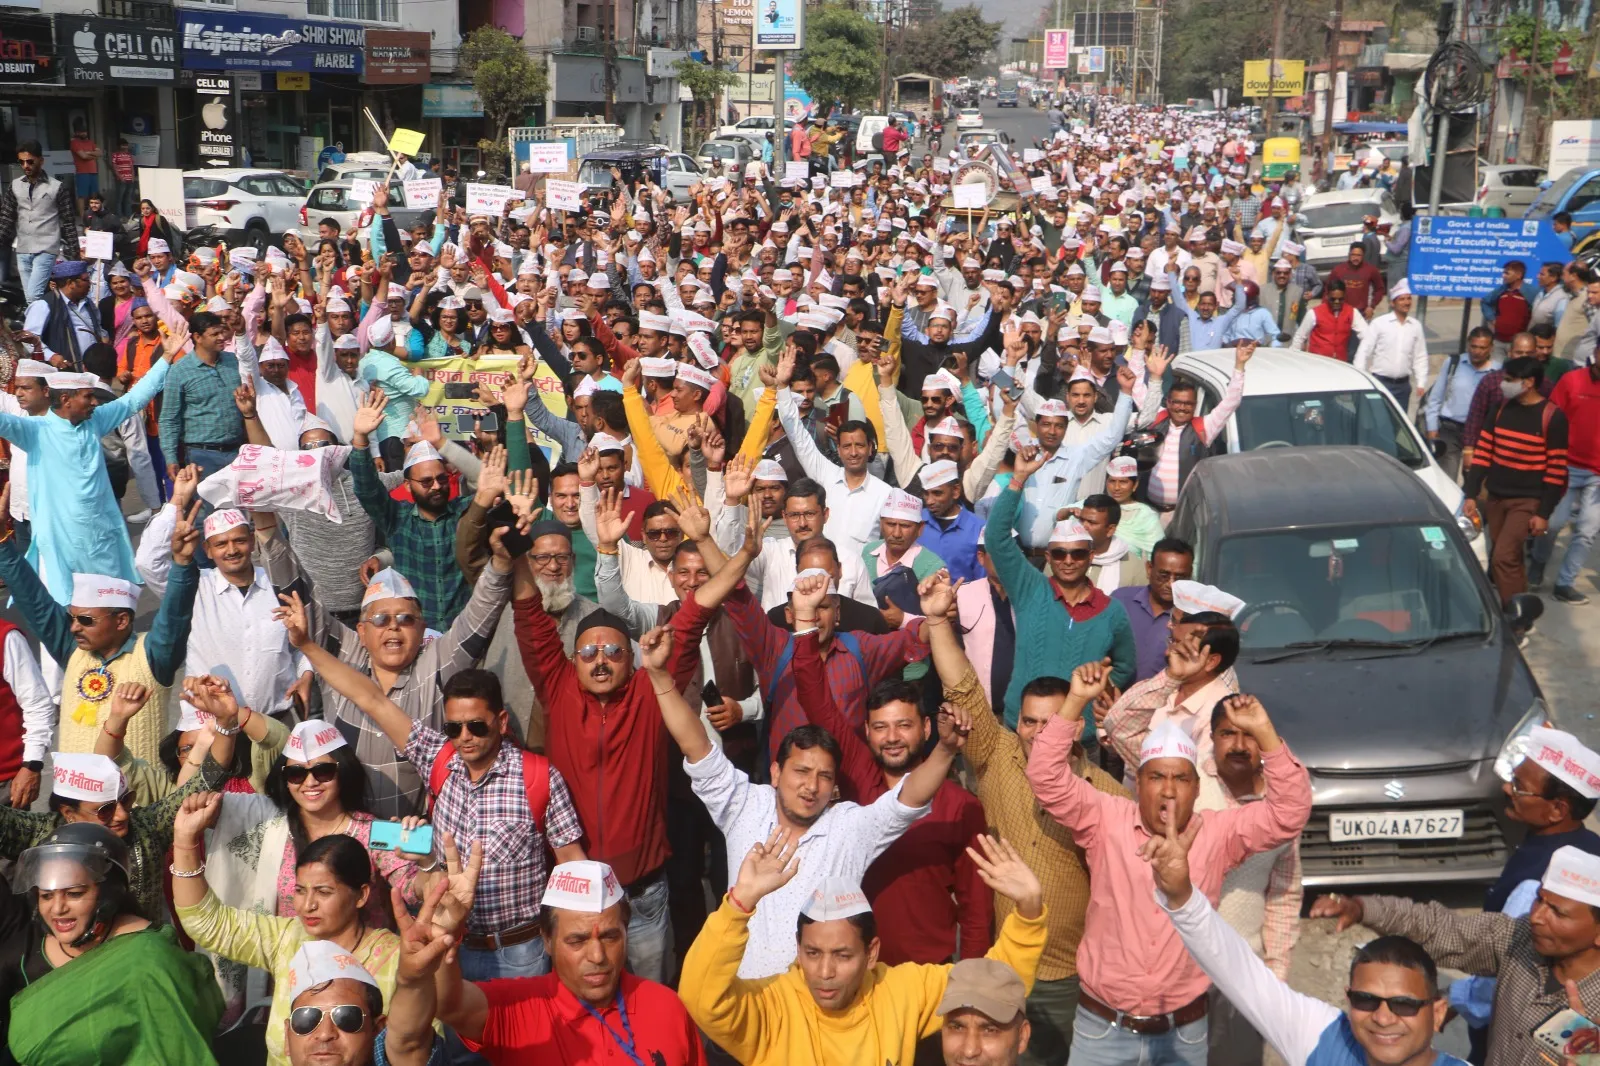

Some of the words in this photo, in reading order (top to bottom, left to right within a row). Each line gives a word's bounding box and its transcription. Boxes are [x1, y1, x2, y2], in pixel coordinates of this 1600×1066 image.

[183, 23, 261, 56] Kajaria
[302, 25, 327, 44] SHRI
[330, 28, 366, 46] SHYAM
[104, 32, 148, 61] CELL
[151, 35, 175, 62] ON
[315, 53, 355, 69] MARBLE
[9, 63, 35, 74] BEAUTY
[73, 67, 104, 81] iPhone
[196, 79, 217, 88] CELL
[218, 80, 229, 89] ON
[1246, 80, 1301, 89] dowtown
[201, 131, 232, 143] iPhone
[200, 146, 231, 156] WHOLESALER
[1447, 221, 1472, 229] Govt.
[1474, 221, 1484, 229] of
[1486, 222, 1510, 230] India
[1415, 236, 1441, 246] Office
[1443, 236, 1452, 246] of
[1453, 237, 1497, 247] Executive
[1497, 239, 1538, 249] Engineer
[68, 769, 105, 792] नैनीताल
[1342, 817, 1460, 836] UK04AA7627
[556, 871, 591, 895] नैनीताल
